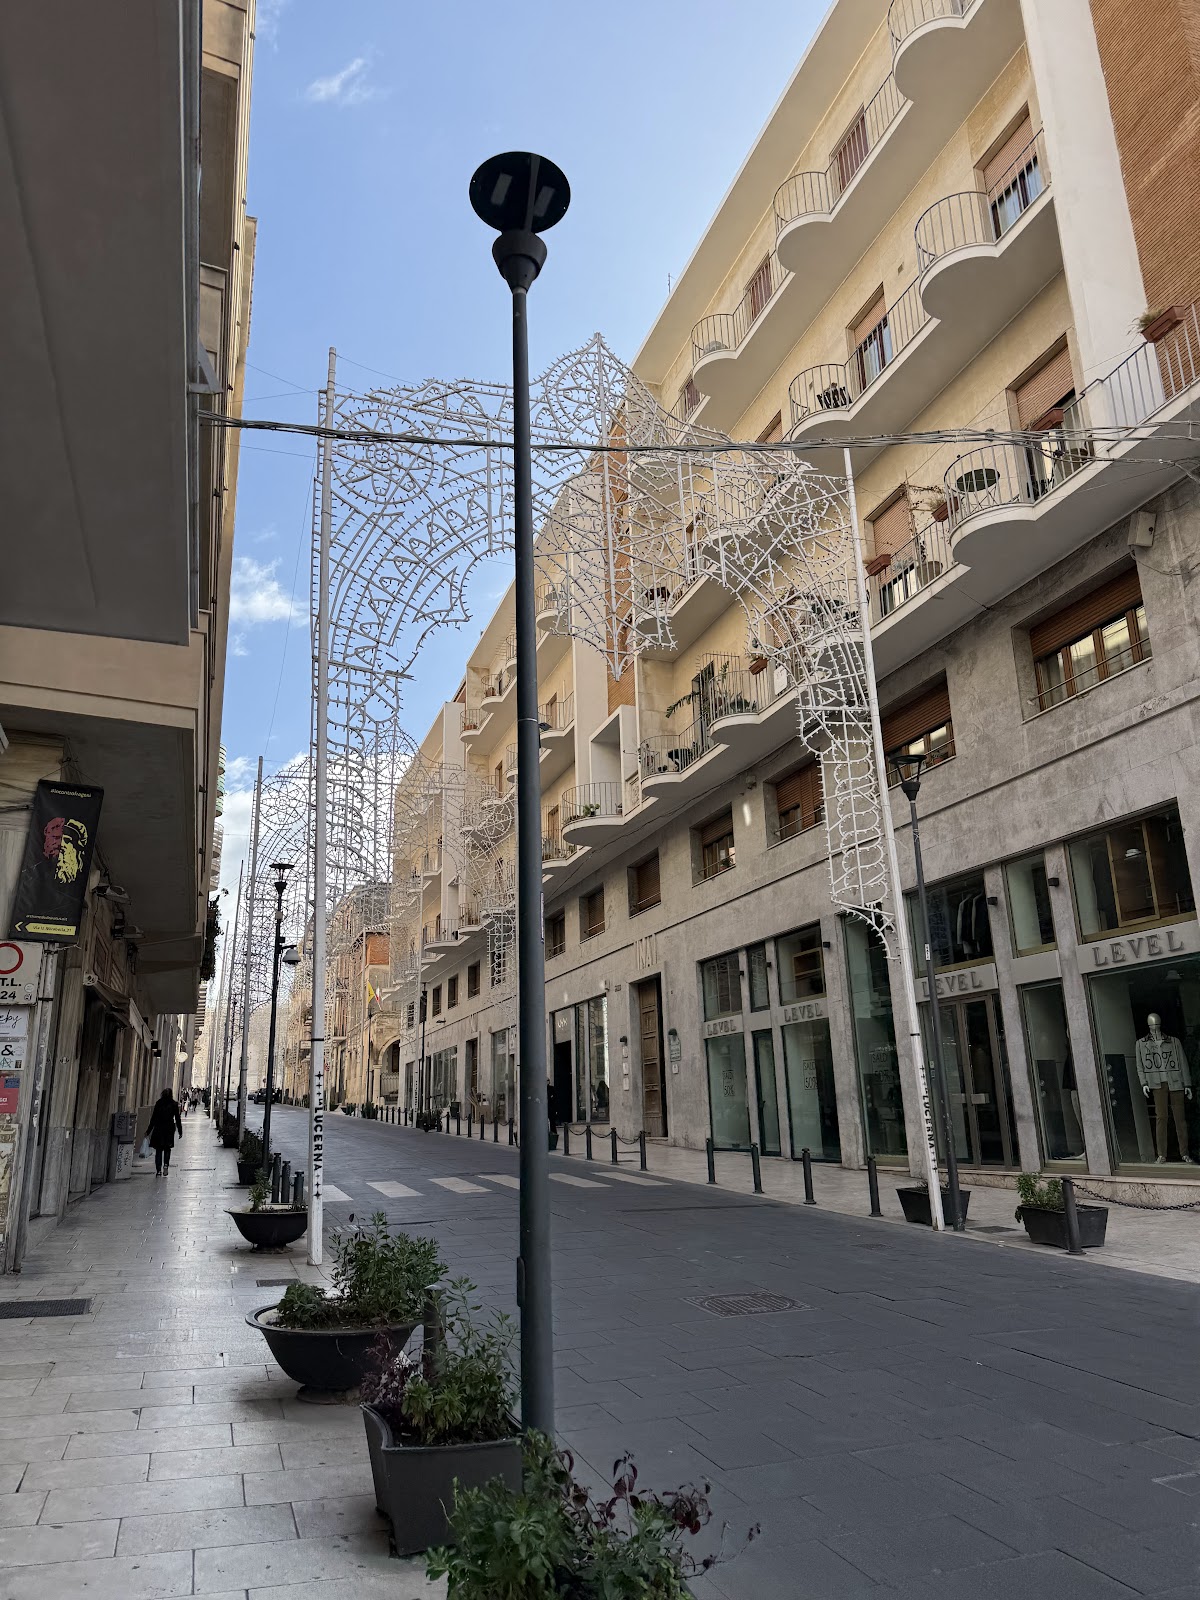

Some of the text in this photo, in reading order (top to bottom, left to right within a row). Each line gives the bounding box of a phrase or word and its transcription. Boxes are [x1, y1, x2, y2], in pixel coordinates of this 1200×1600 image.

[1092, 931, 1184, 967] LEVEL
[784, 1003, 824, 1022] LEVEL
[707, 1019, 737, 1036] LEVEL
[1145, 1051, 1176, 1070] 50%
[313, 1107, 323, 1171] LUCERNA
